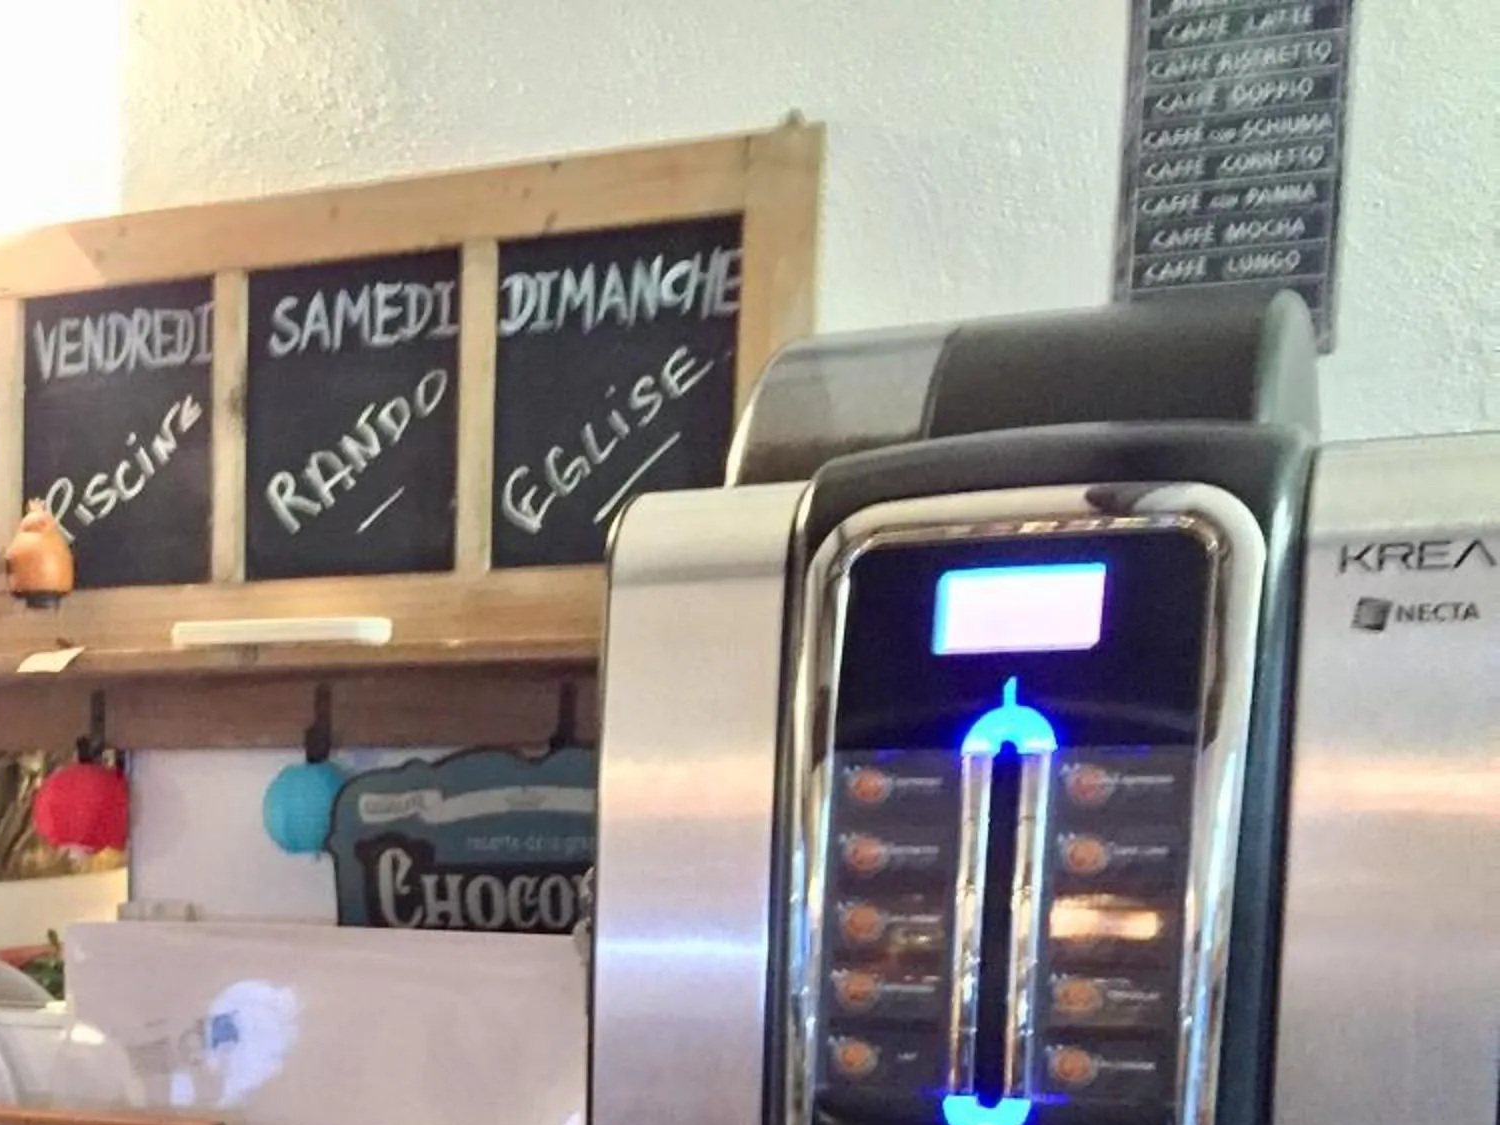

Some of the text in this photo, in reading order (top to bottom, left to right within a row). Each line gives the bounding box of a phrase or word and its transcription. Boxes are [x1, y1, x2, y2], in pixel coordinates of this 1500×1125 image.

[268, 279, 458, 357] SAMEDI
[500, 246, 741, 335] DIMANCHE
[33, 303, 213, 379] VENDREDI
[265, 369, 449, 533] RANDO
[1339, 538, 1497, 573] KREA
[1395, 602, 1481, 622] NECTA
[377, 847, 585, 929] CHOCO
